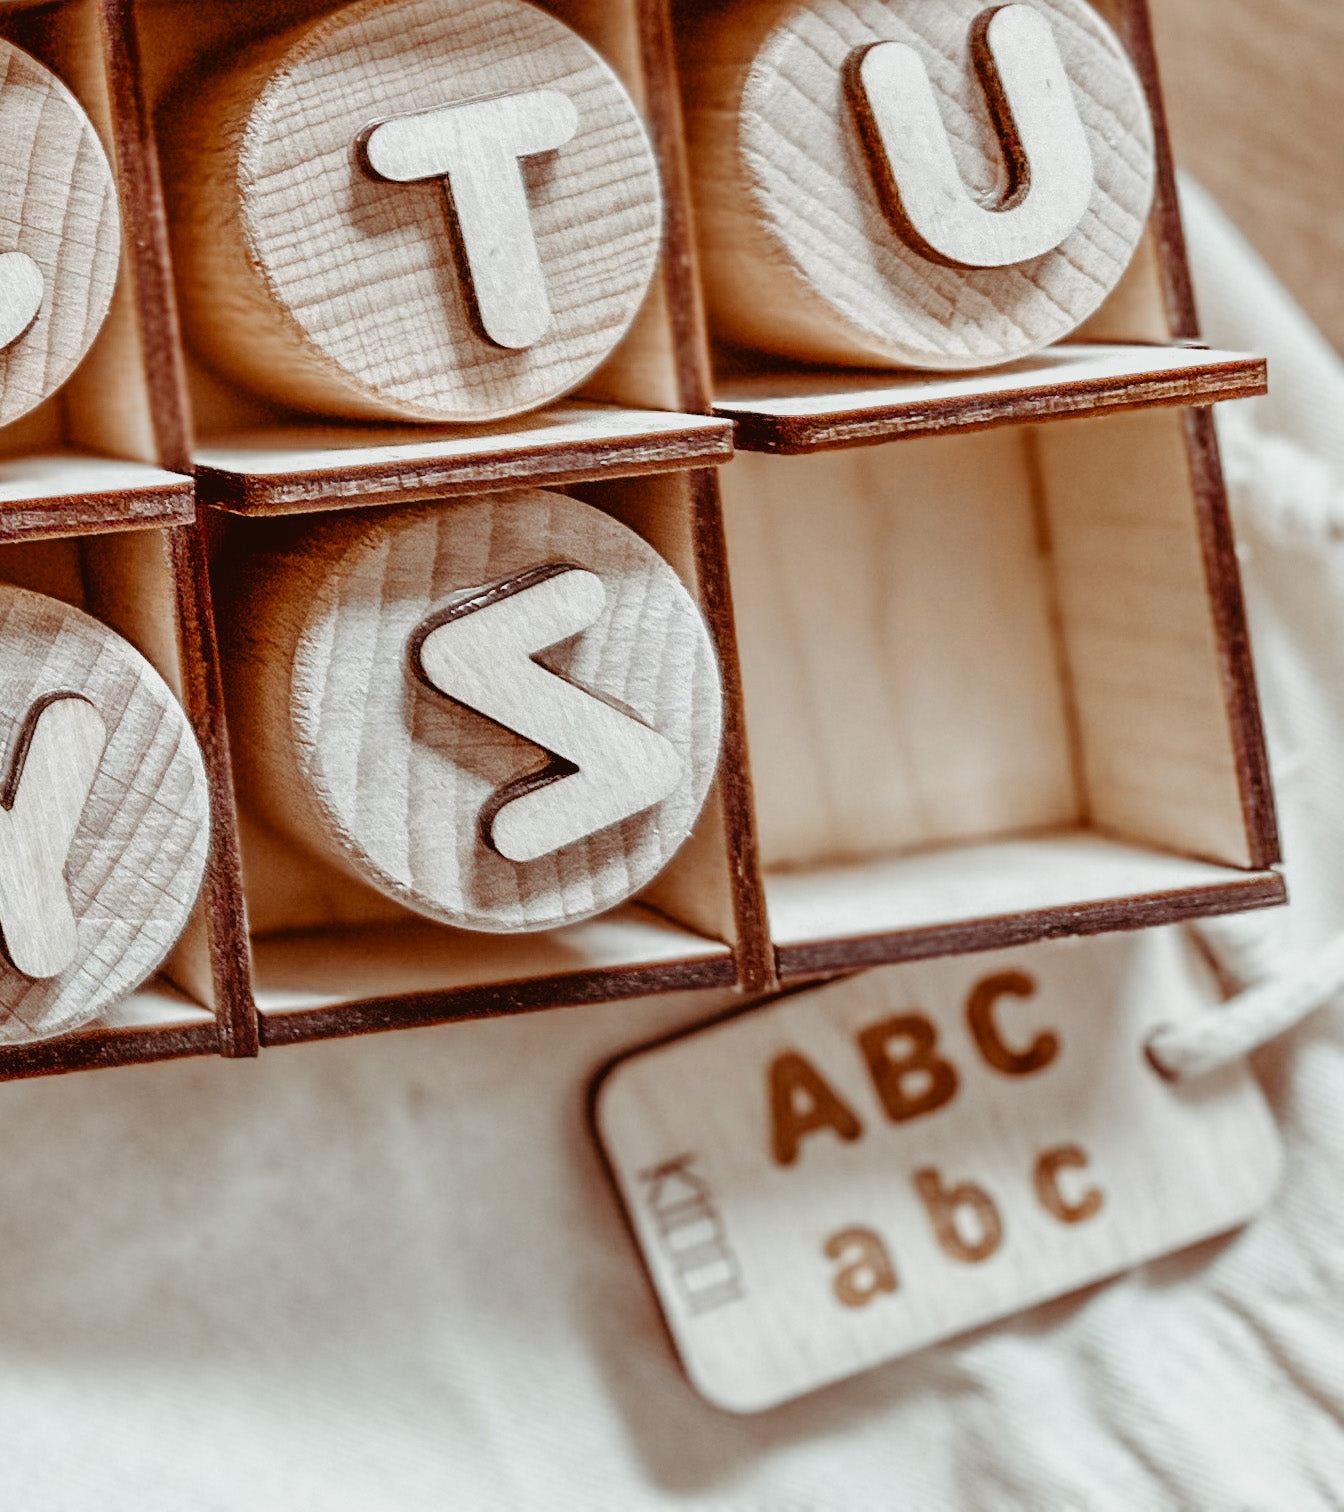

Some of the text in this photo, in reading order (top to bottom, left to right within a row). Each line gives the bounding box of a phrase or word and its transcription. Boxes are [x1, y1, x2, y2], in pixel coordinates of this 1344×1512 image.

[362, 88, 581, 350] T
[855, 2, 1095, 269] U
[763, 967, 1061, 1170] ABC
